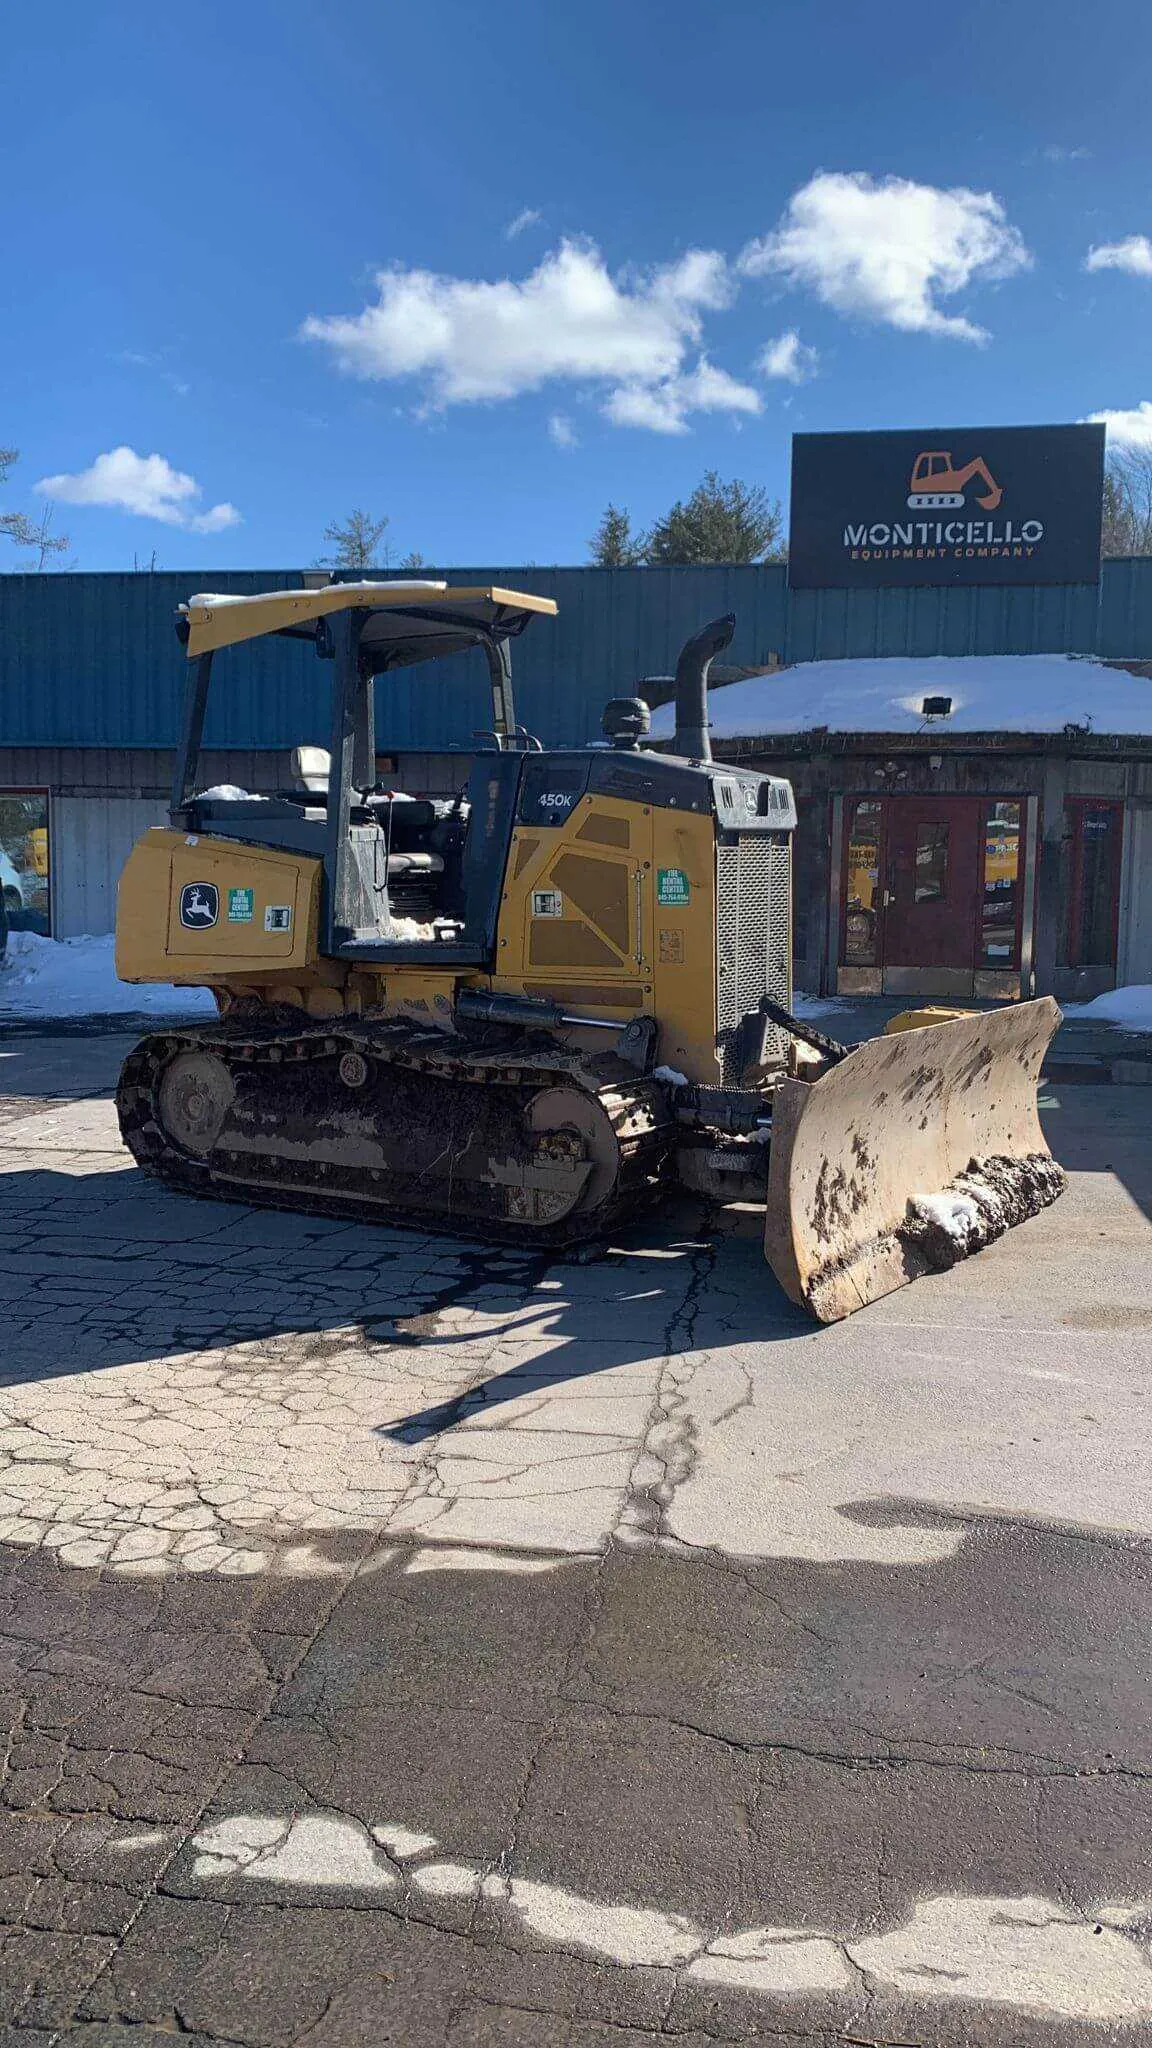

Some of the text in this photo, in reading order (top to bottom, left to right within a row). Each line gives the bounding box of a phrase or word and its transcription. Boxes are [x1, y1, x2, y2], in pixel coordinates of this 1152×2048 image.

[843, 520, 1044, 546] MONTICELLO
[851, 546, 1035, 561] EQUIPMENT COMPANY
[538, 793, 572, 807] 450K
